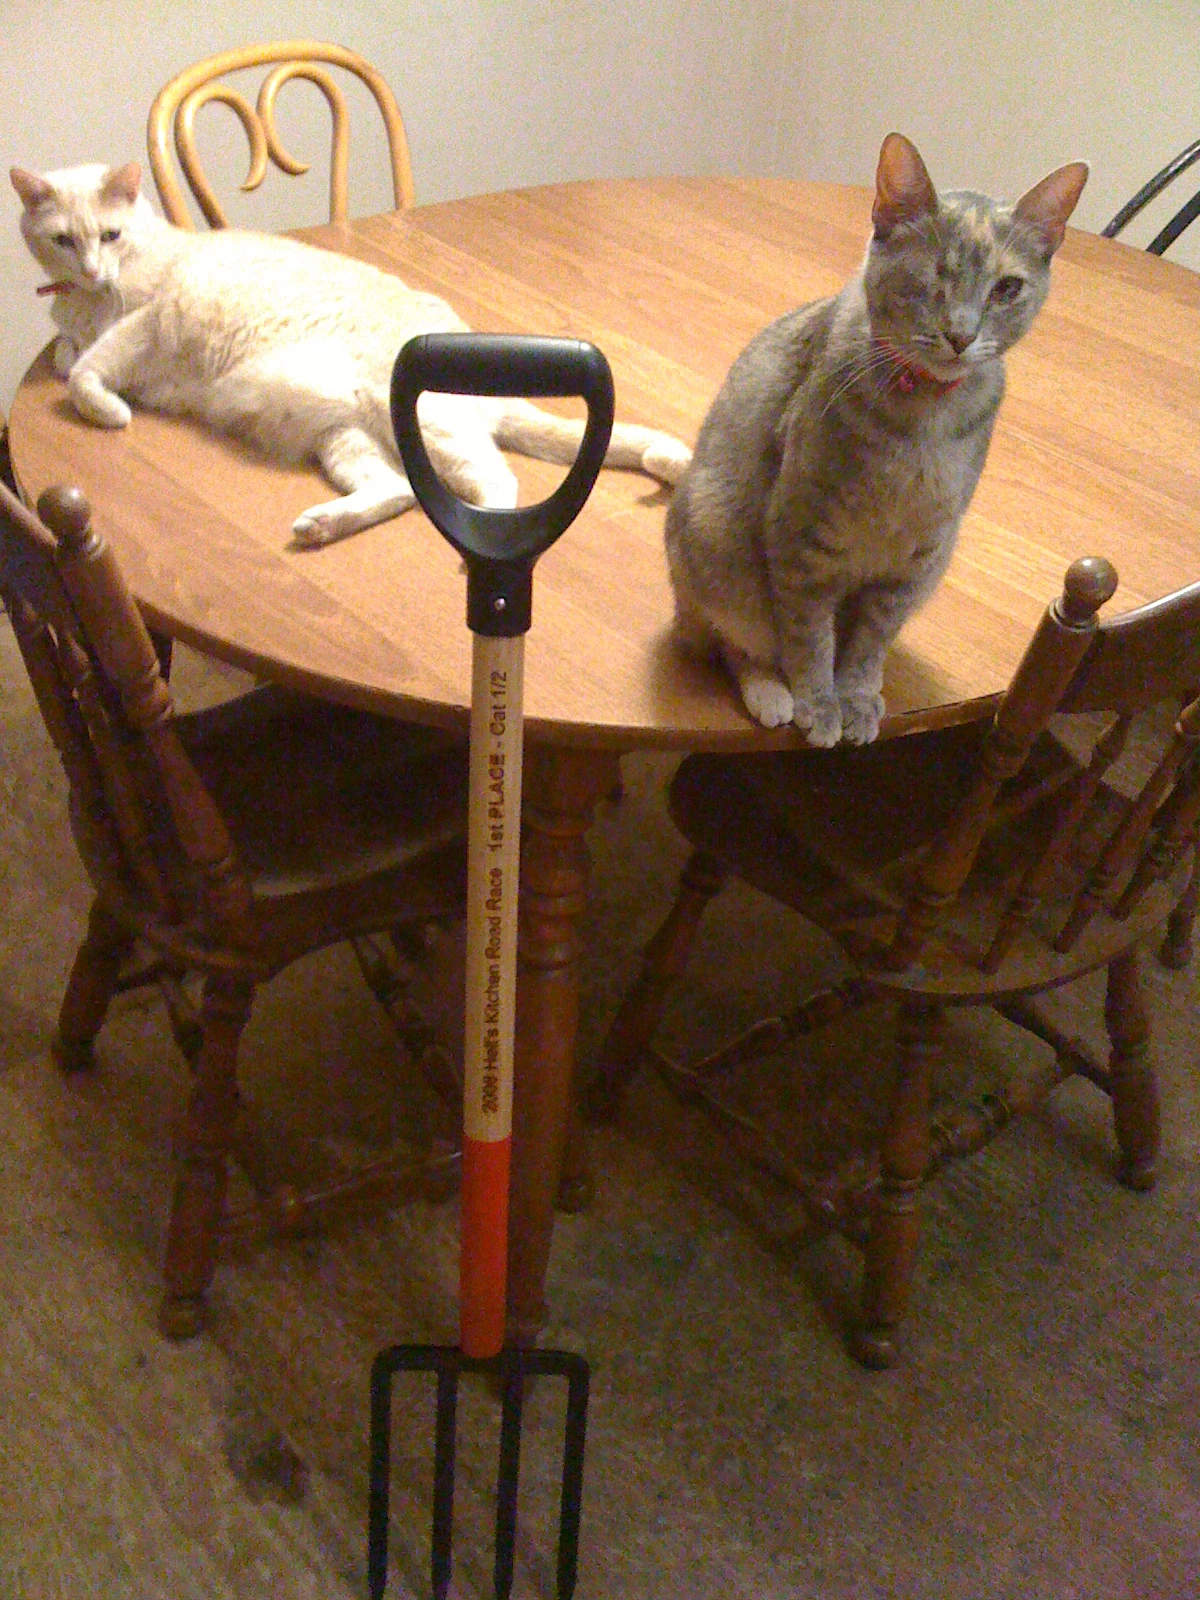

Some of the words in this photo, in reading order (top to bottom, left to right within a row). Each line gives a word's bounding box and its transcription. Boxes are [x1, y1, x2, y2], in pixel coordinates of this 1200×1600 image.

[490, 671, 507, 697] 1/2
[489, 705, 506, 736] Cat
[488, 754, 505, 819] PLACE
[488, 825, 503, 852] 1st
[486, 867, 502, 910] Race
[485, 916, 502, 959] Road
[484, 964, 501, 1023] Kitchen
